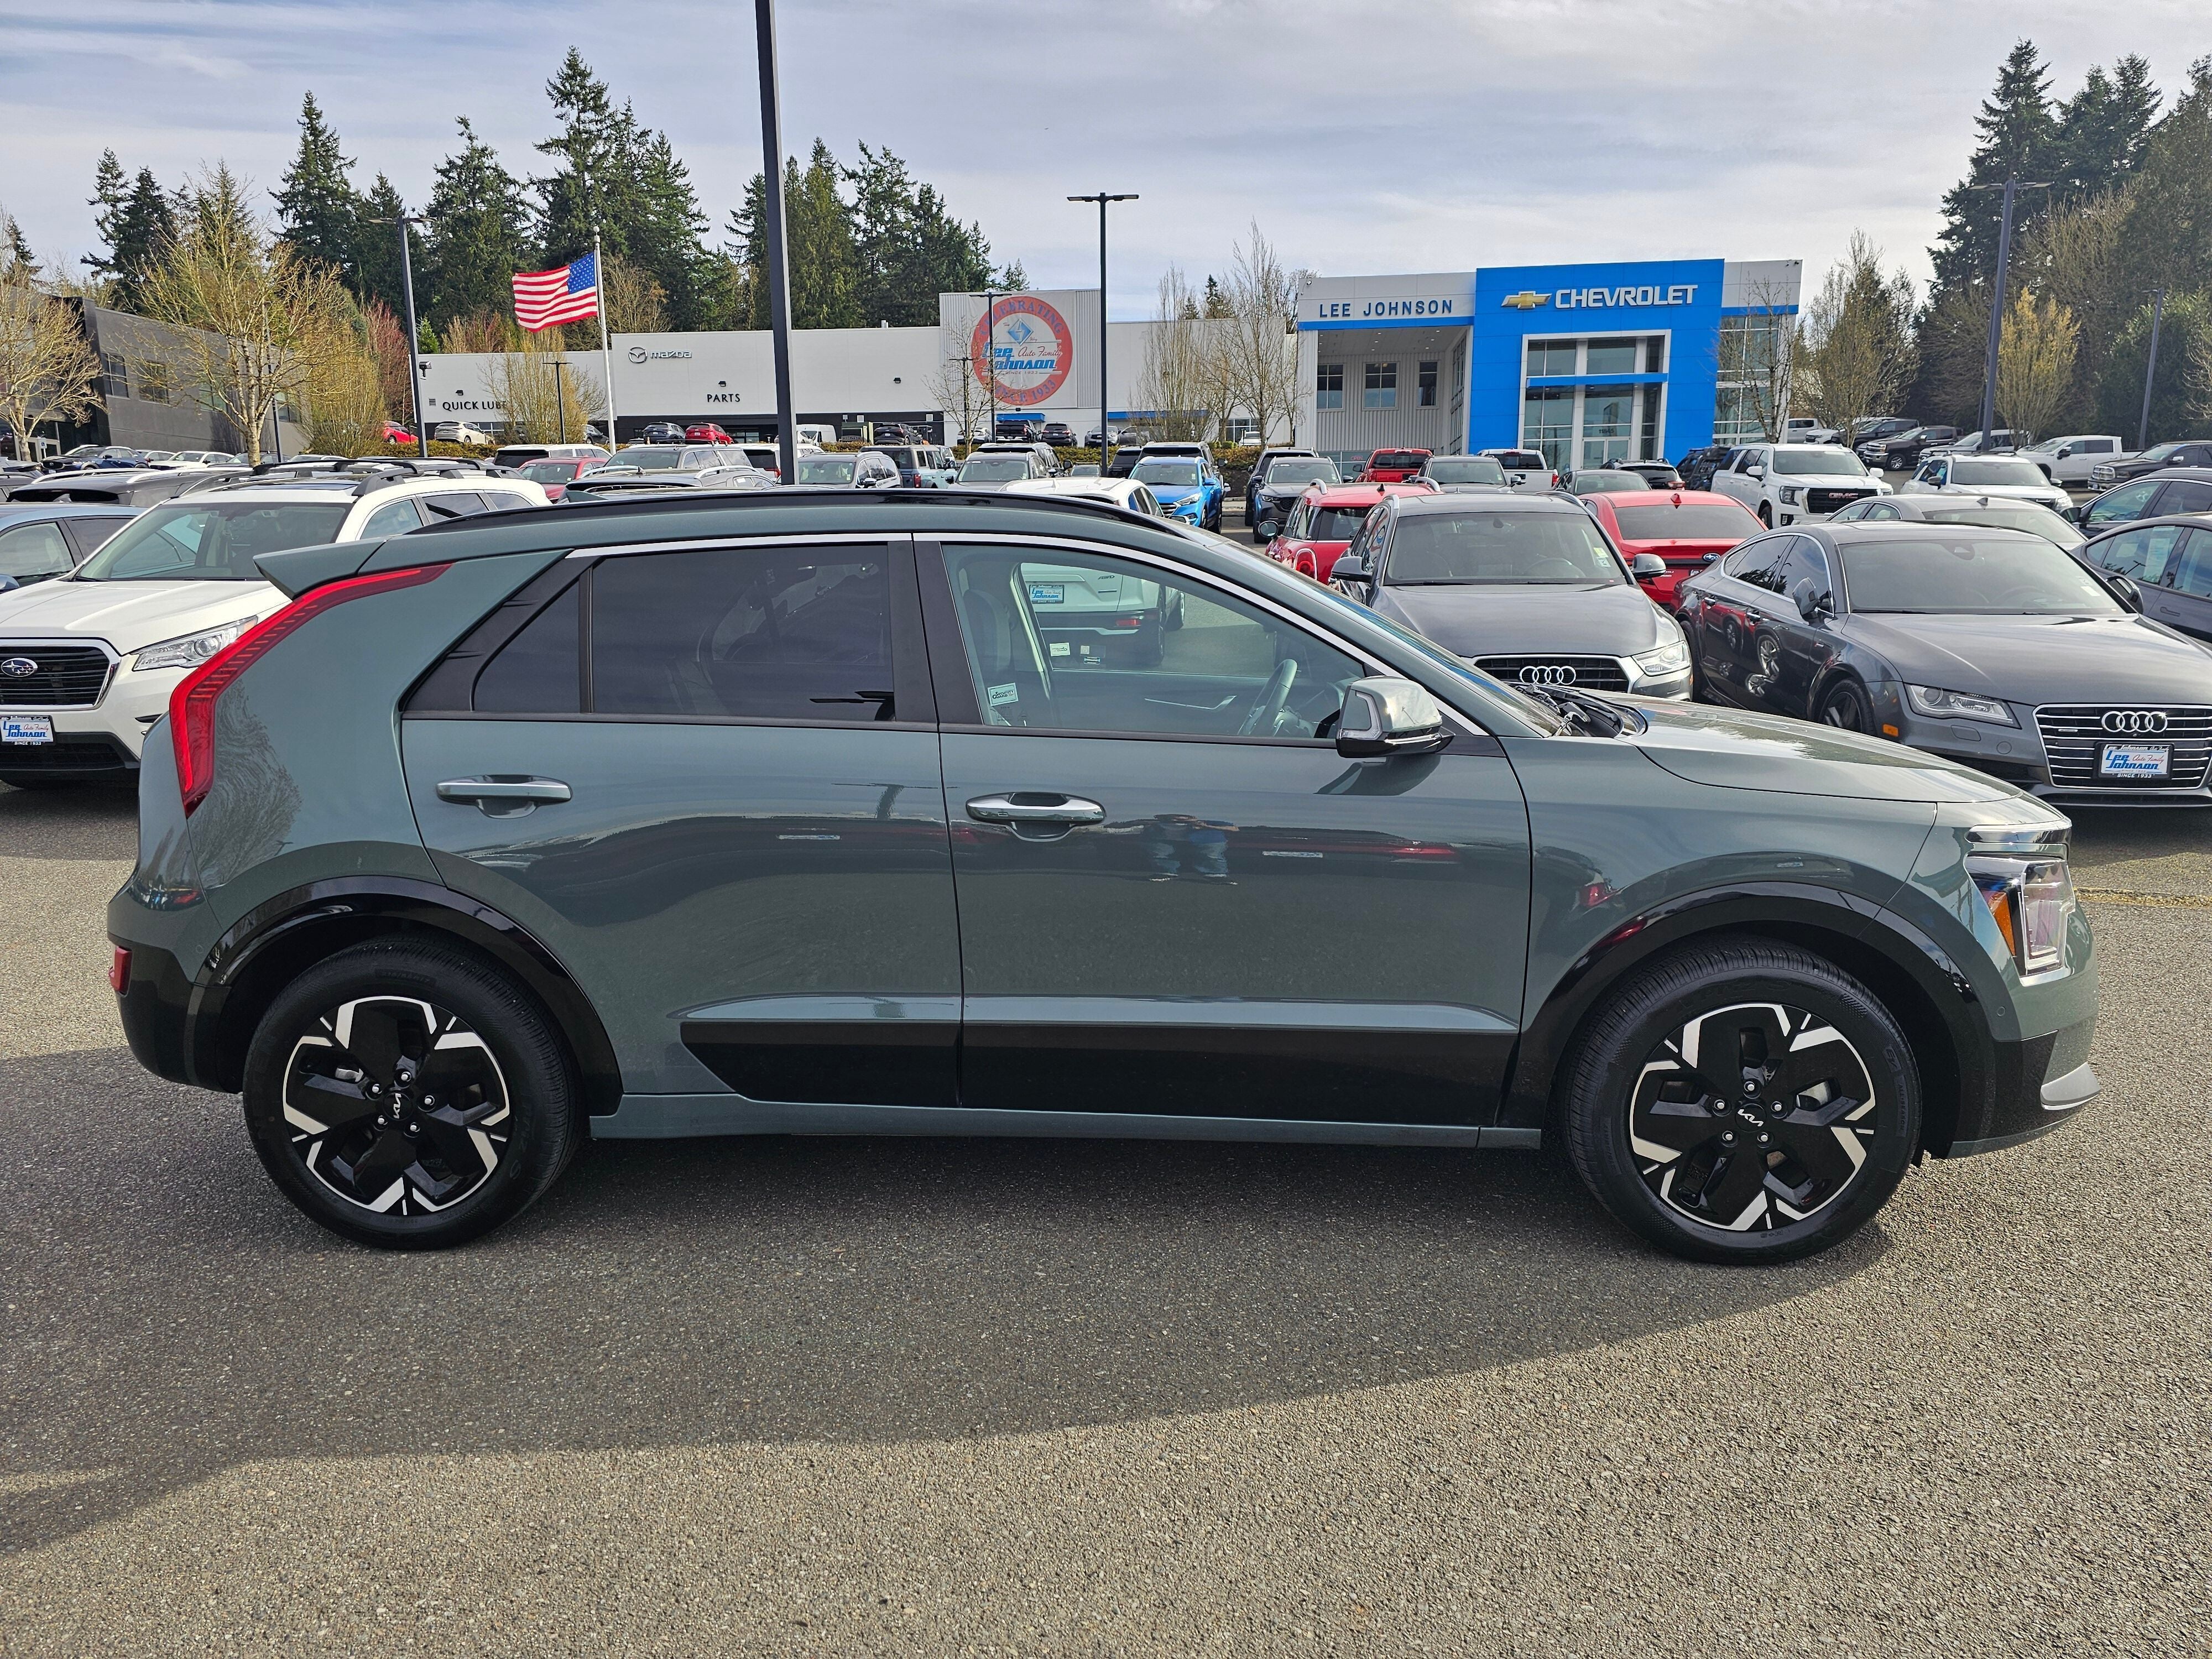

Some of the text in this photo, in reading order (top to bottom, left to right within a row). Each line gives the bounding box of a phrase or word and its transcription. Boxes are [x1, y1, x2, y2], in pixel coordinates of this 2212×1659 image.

[1555, 285, 1698, 309] CHEVROLET
[1319, 300, 1452, 317] LEE JOHNSON
[1018, 346, 1036, 357] Auto
[1037, 345, 1063, 359] Family
[983, 354, 1056, 370] ohnson
[1032, 379, 1056, 400] 1933
[707, 393, 740, 402] PARTS
[442, 401, 479, 411] QUICK
[3, 721, 22, 730] Lee
[6, 727, 48, 737] Johnson
[2106, 750, 2130, 761] Lee
[2147, 754, 2164, 764] Family
[2106, 757, 2159, 769] Johnson
